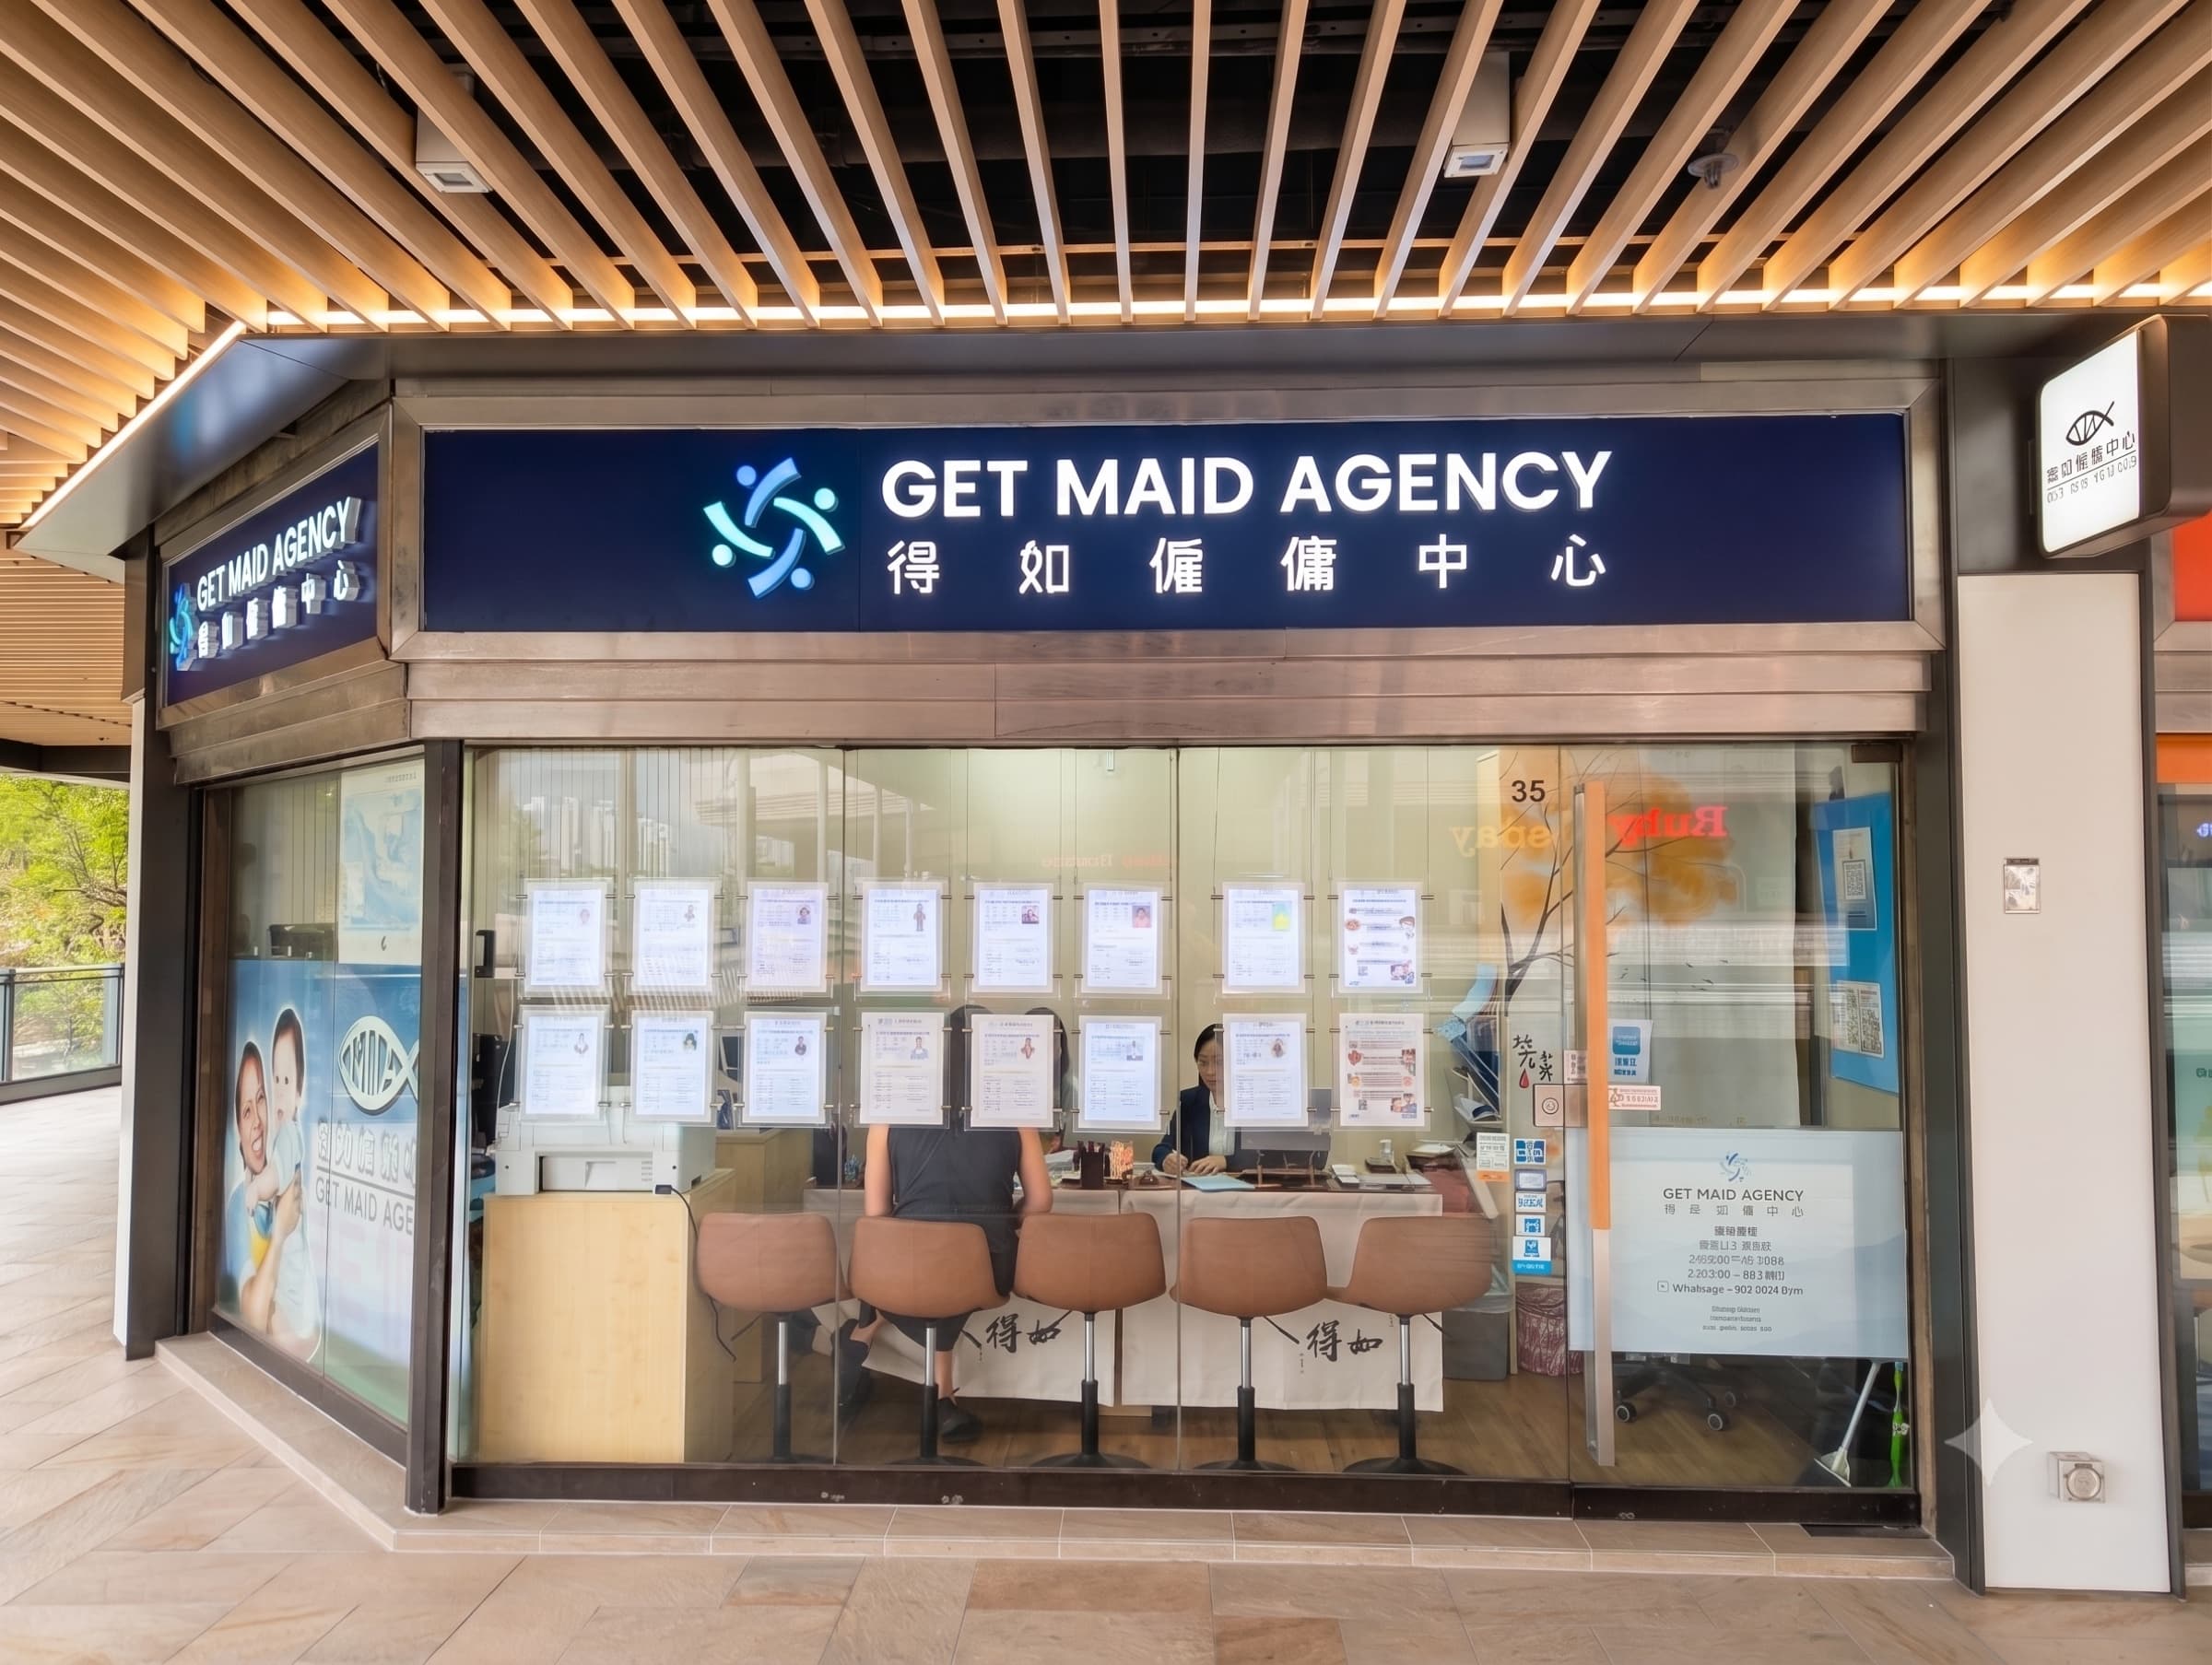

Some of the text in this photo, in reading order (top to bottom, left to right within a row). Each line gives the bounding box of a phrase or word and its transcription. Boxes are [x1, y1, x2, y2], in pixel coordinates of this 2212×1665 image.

[881, 450, 1613, 519] GET MAID AGENCY
[197, 497, 356, 612] GET MAID AGENCY
[1512, 780, 1546, 803] 35
[315, 1177, 414, 1236] GET MAID AGE
[1663, 1188, 1804, 1202] GET MAID AGENCY
[985, 1313, 1062, 1354] 得如
[1306, 1319, 1383, 1362] 得如
